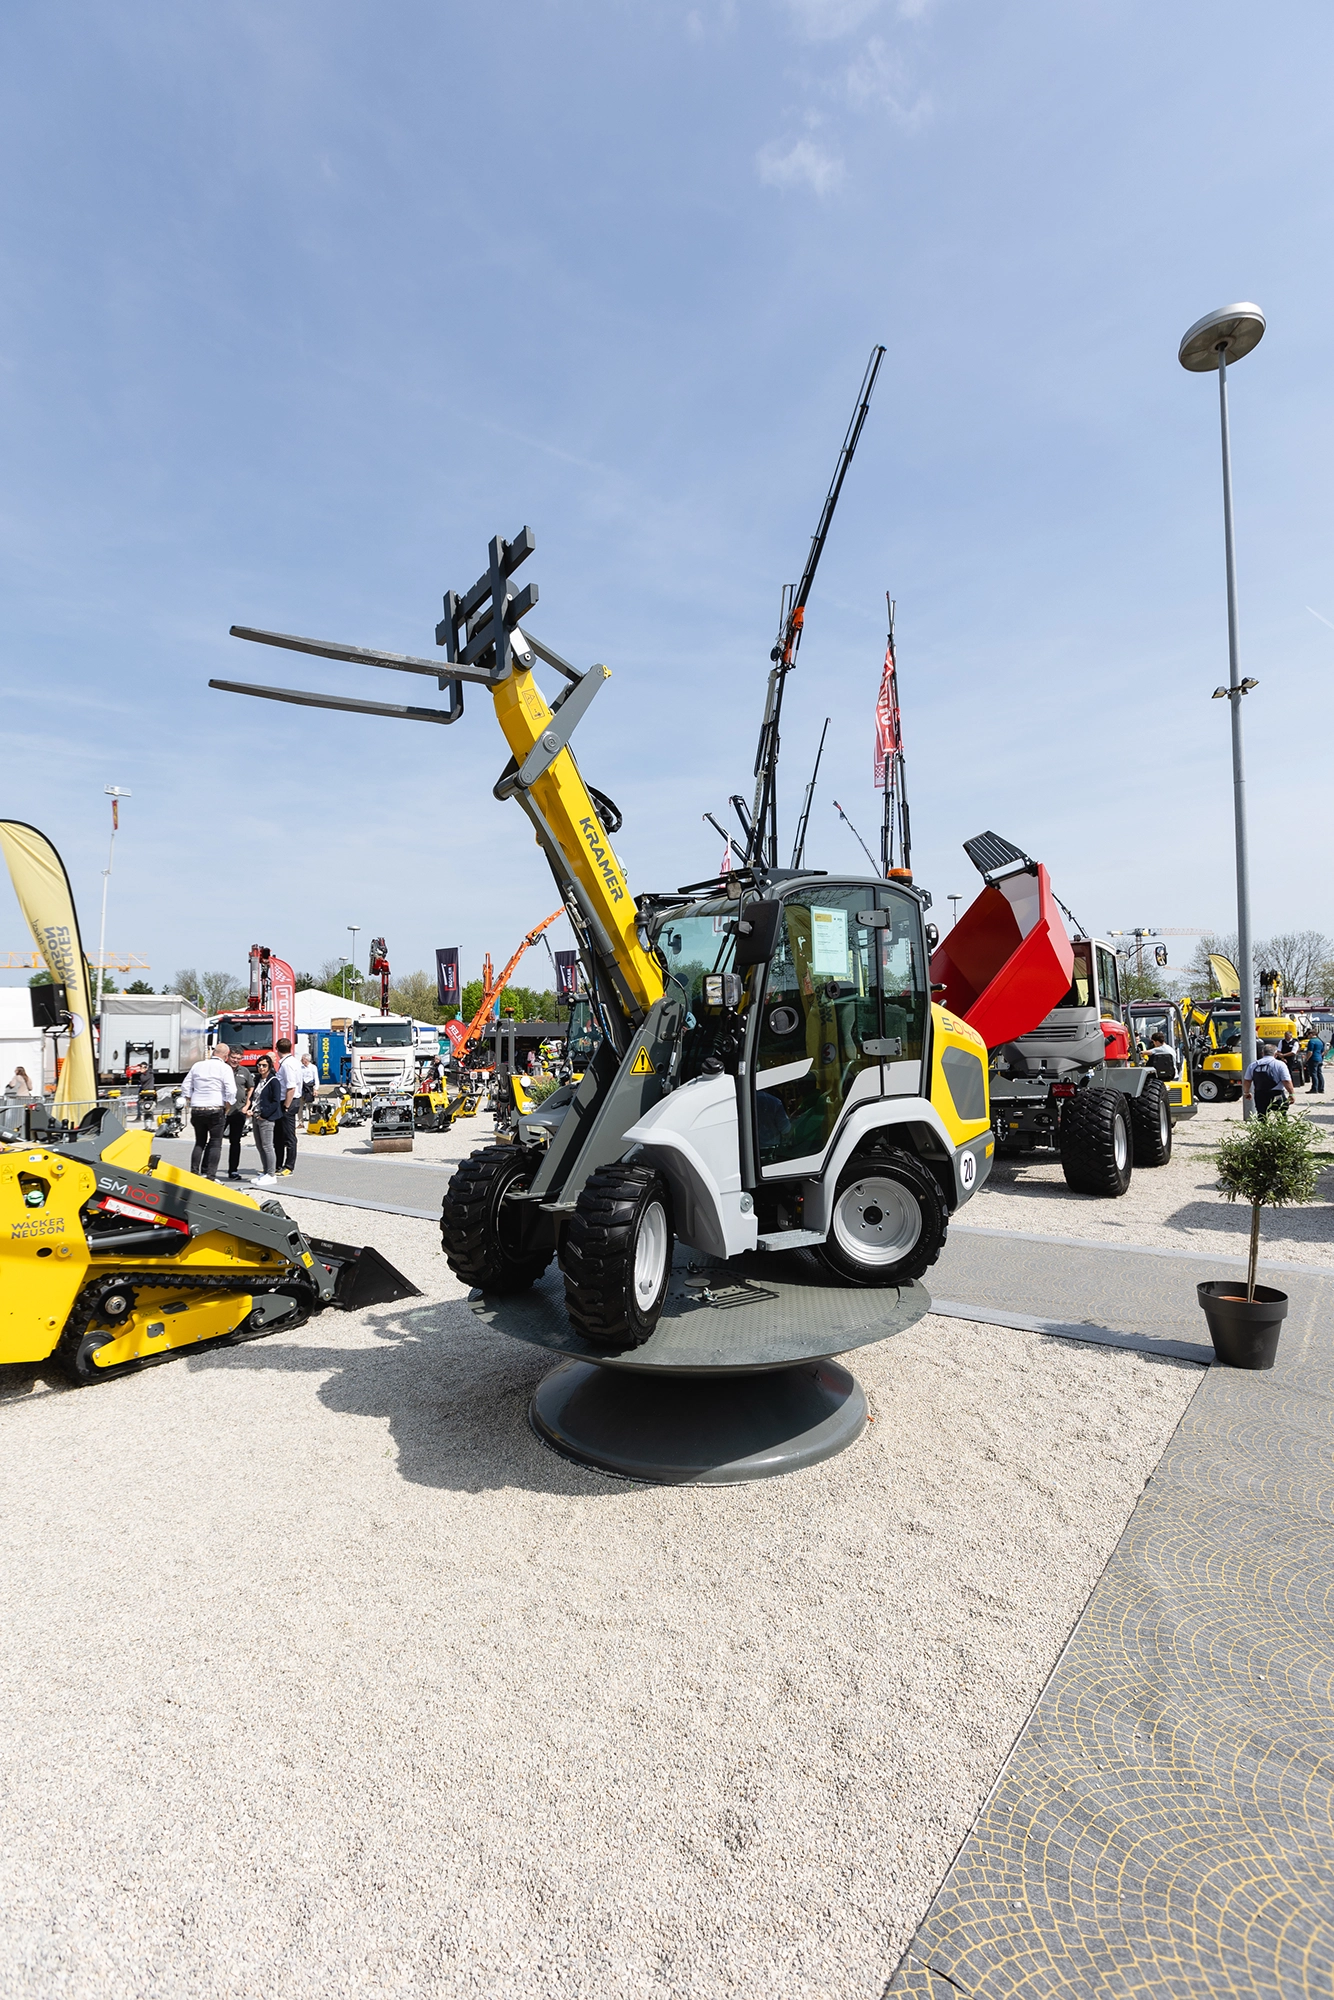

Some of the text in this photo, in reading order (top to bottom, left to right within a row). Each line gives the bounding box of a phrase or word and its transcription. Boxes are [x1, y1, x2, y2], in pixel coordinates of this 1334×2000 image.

[579, 816, 624, 904] KRAMER
[941, 1016, 982, 1046] 5040
[963, 1157, 973, 1183] 20
[98, 1177, 160, 1205] SM100
[11, 1218, 64, 1231] WACKER
[11, 1226, 64, 1239] NEUSON
